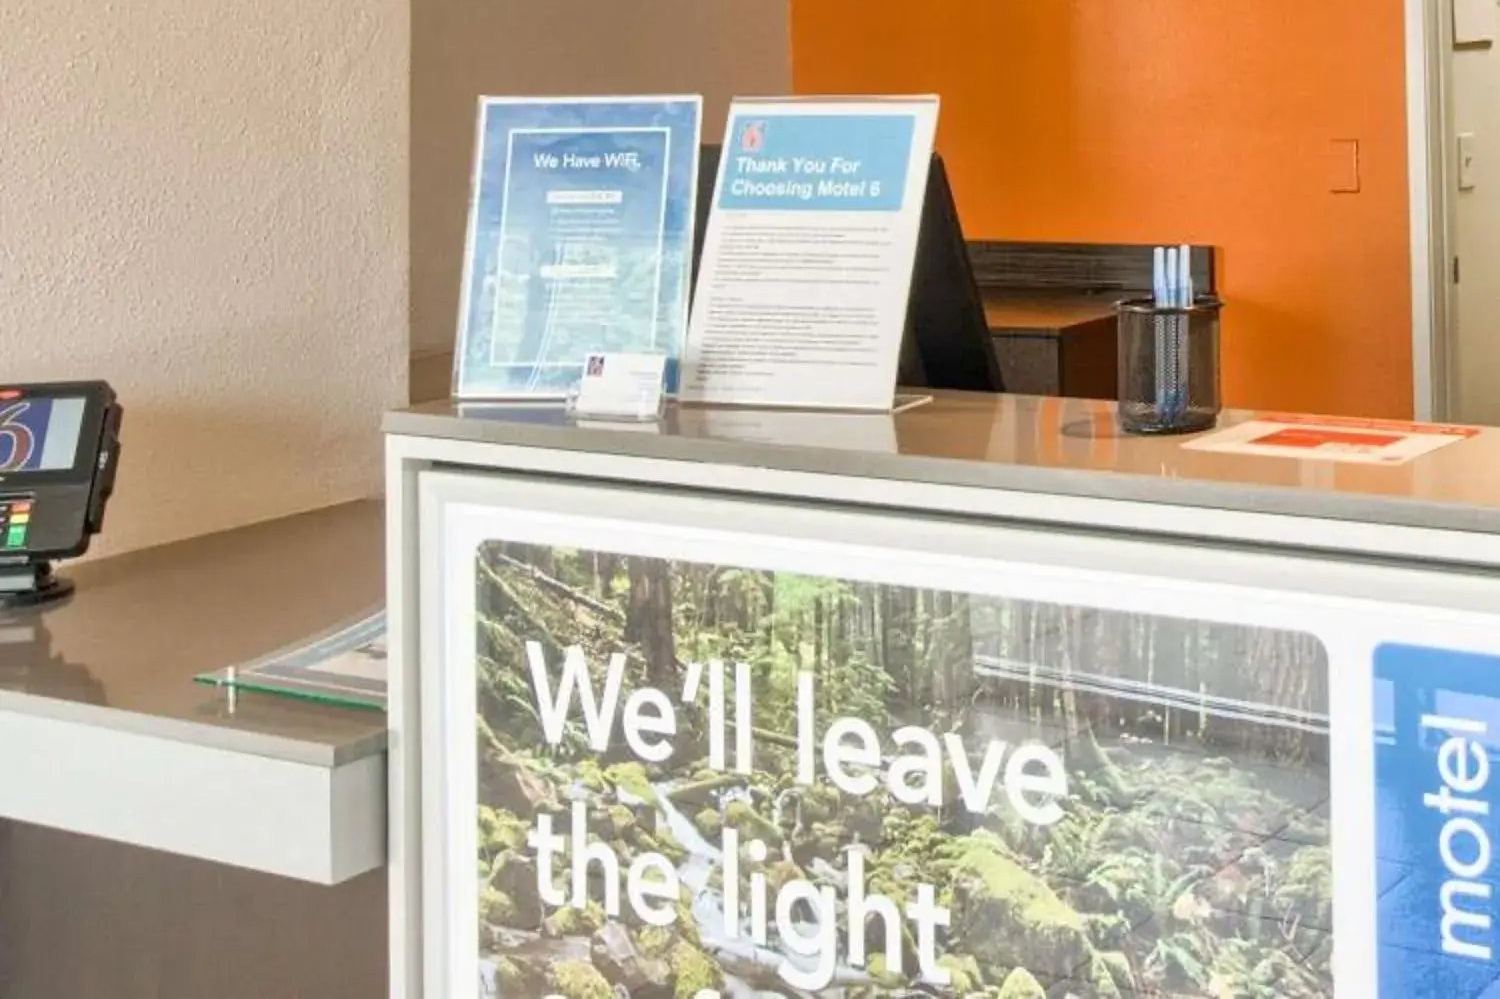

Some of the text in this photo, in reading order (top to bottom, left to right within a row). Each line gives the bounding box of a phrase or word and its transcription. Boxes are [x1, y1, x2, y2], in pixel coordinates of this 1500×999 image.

[533, 152, 559, 169] We
[563, 152, 601, 169] Have
[731, 179, 881, 200] Choosing Motel 6
[736, 157, 861, 175] Thank You For
[525, 640, 1068, 826] We'll leave
[1420, 714, 1493, 963] motel
[528, 802, 952, 991] the light
